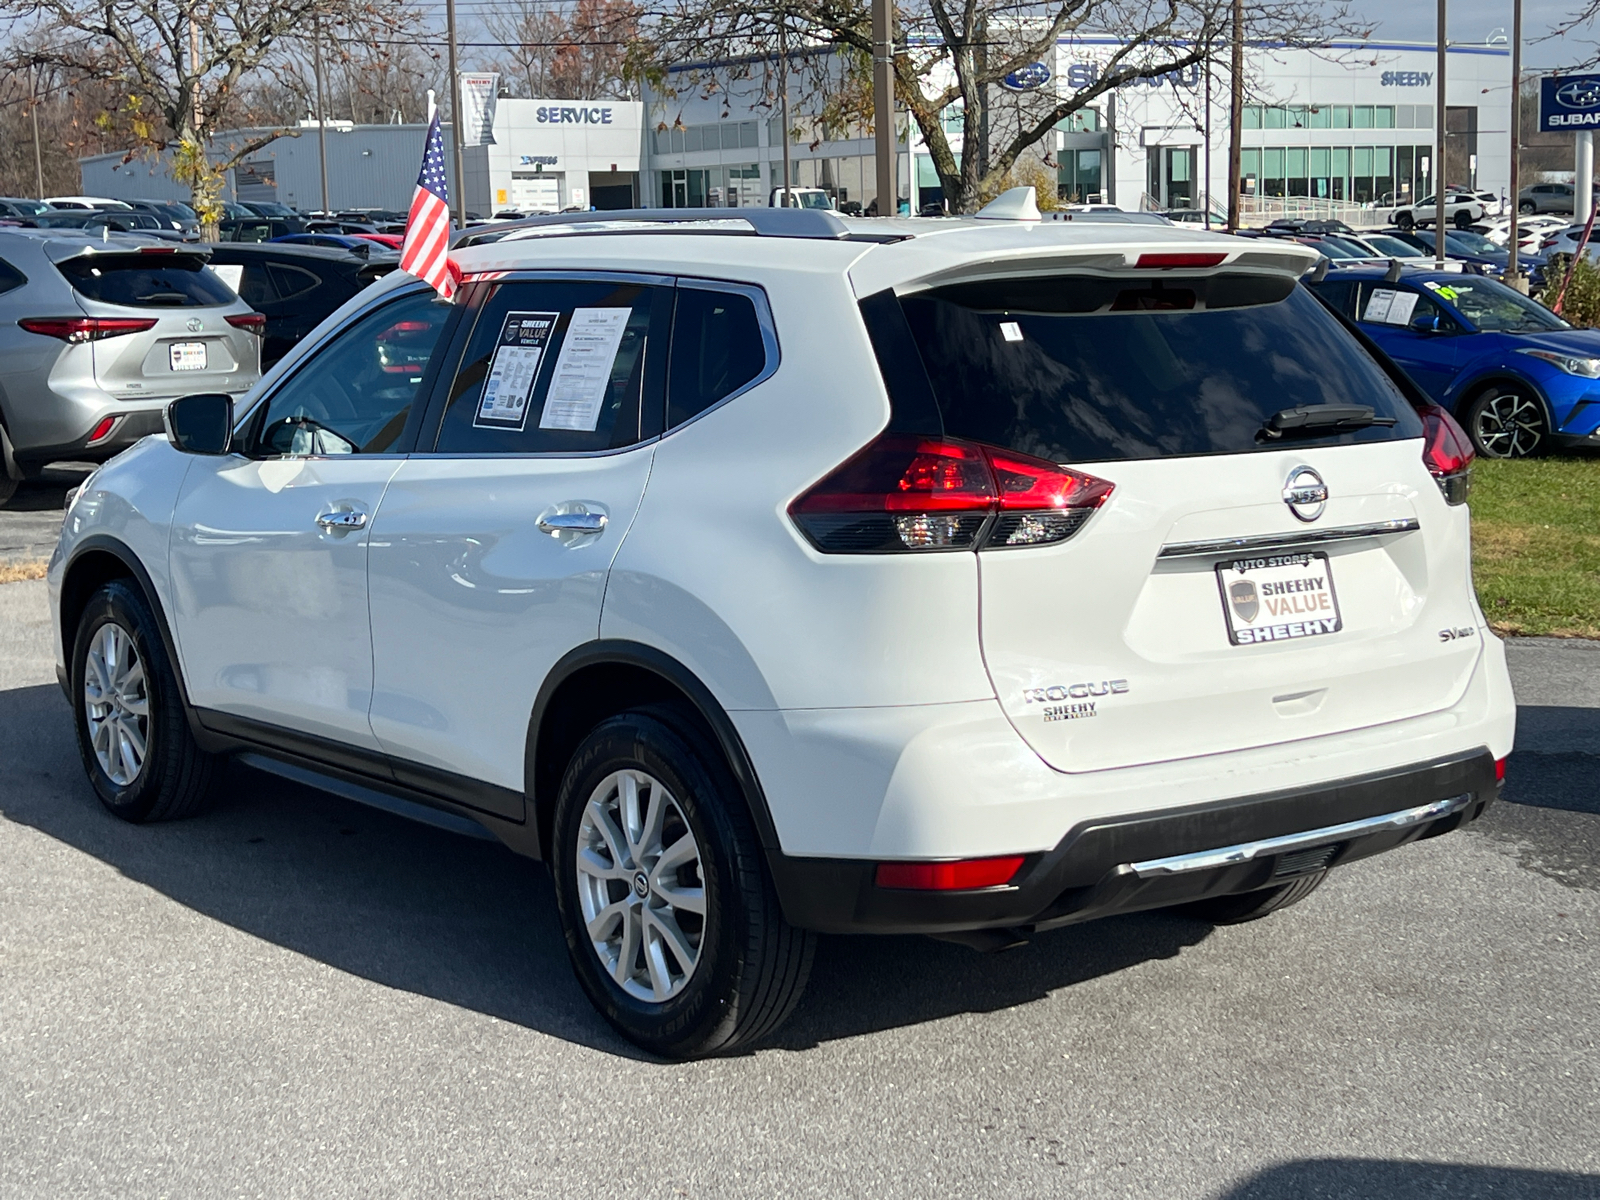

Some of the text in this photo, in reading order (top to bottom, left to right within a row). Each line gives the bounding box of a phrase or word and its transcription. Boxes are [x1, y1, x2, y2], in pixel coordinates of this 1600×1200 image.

[1380, 70, 1434, 87] SHEEHY
[536, 106, 613, 124] SERVICE
[520, 319, 551, 328] SHEEHY
[519, 327, 548, 339] VALUE
[1231, 553, 1315, 571] AUTO STORES
[1261, 576, 1325, 597] SHEEHY
[1264, 592, 1331, 617] VALUE
[1236, 618, 1338, 645] SHEEHY
[1023, 678, 1130, 704] ROGUE
[1043, 701, 1096, 717] SHEEHY
